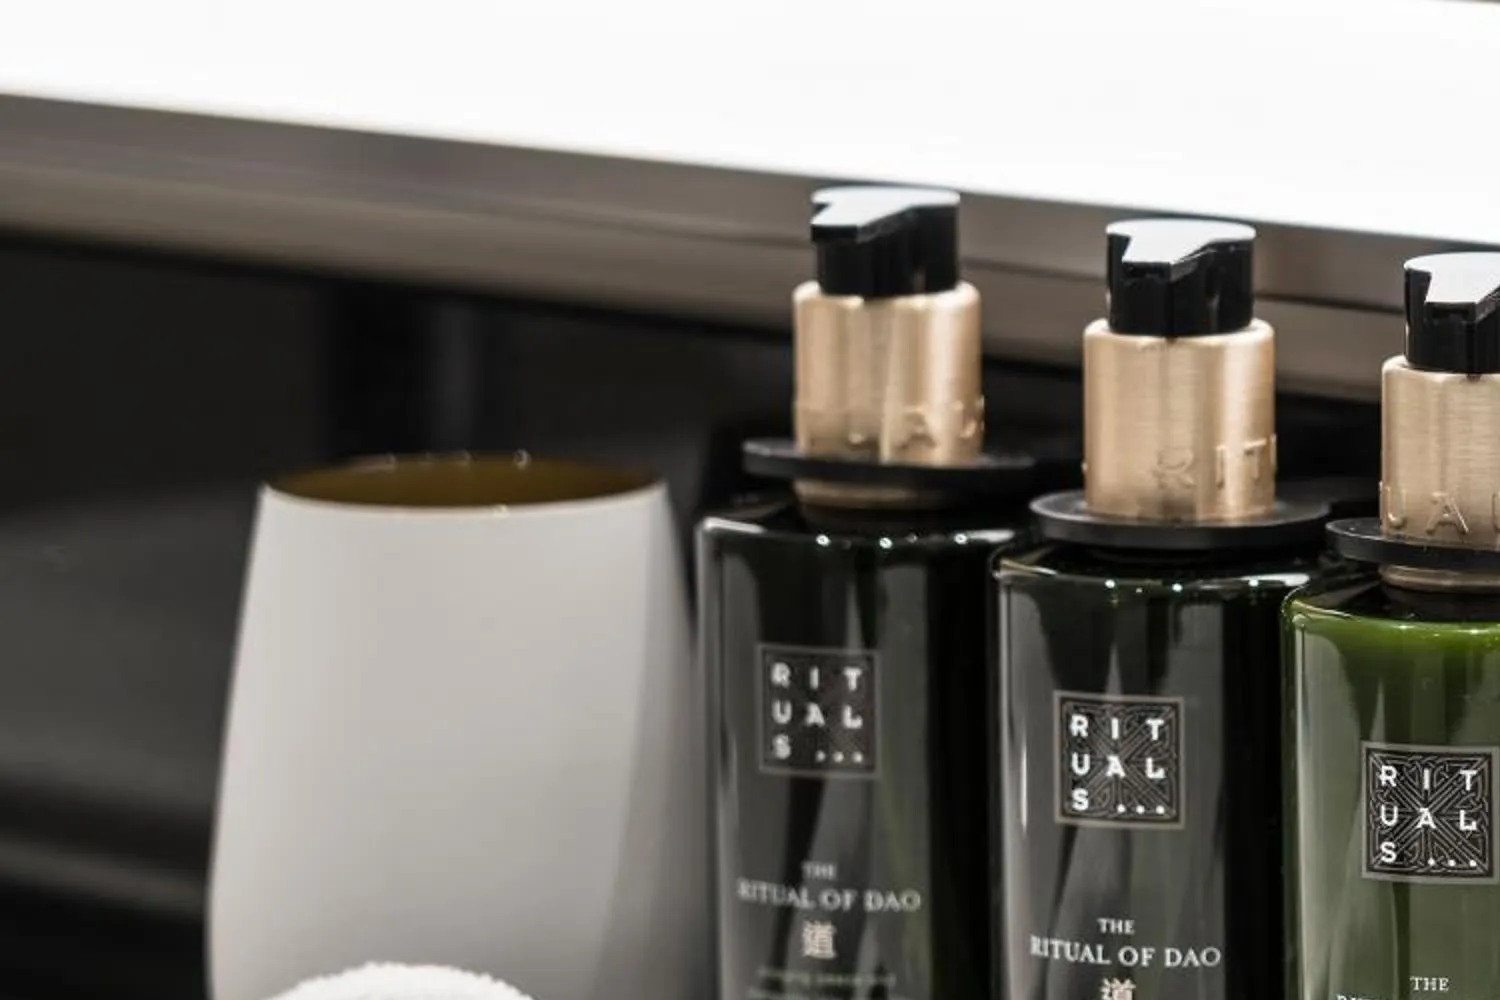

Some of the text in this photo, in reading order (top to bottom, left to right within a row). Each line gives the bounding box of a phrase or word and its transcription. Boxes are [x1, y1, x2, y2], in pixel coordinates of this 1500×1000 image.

[802, 861, 837, 880] THE
[737, 878, 922, 912] RITUAL OF DAO
[1097, 918, 1135, 935] THE
[1030, 935, 1223, 968] RITUAL OF DAO
[1410, 976, 1450, 992] THE
